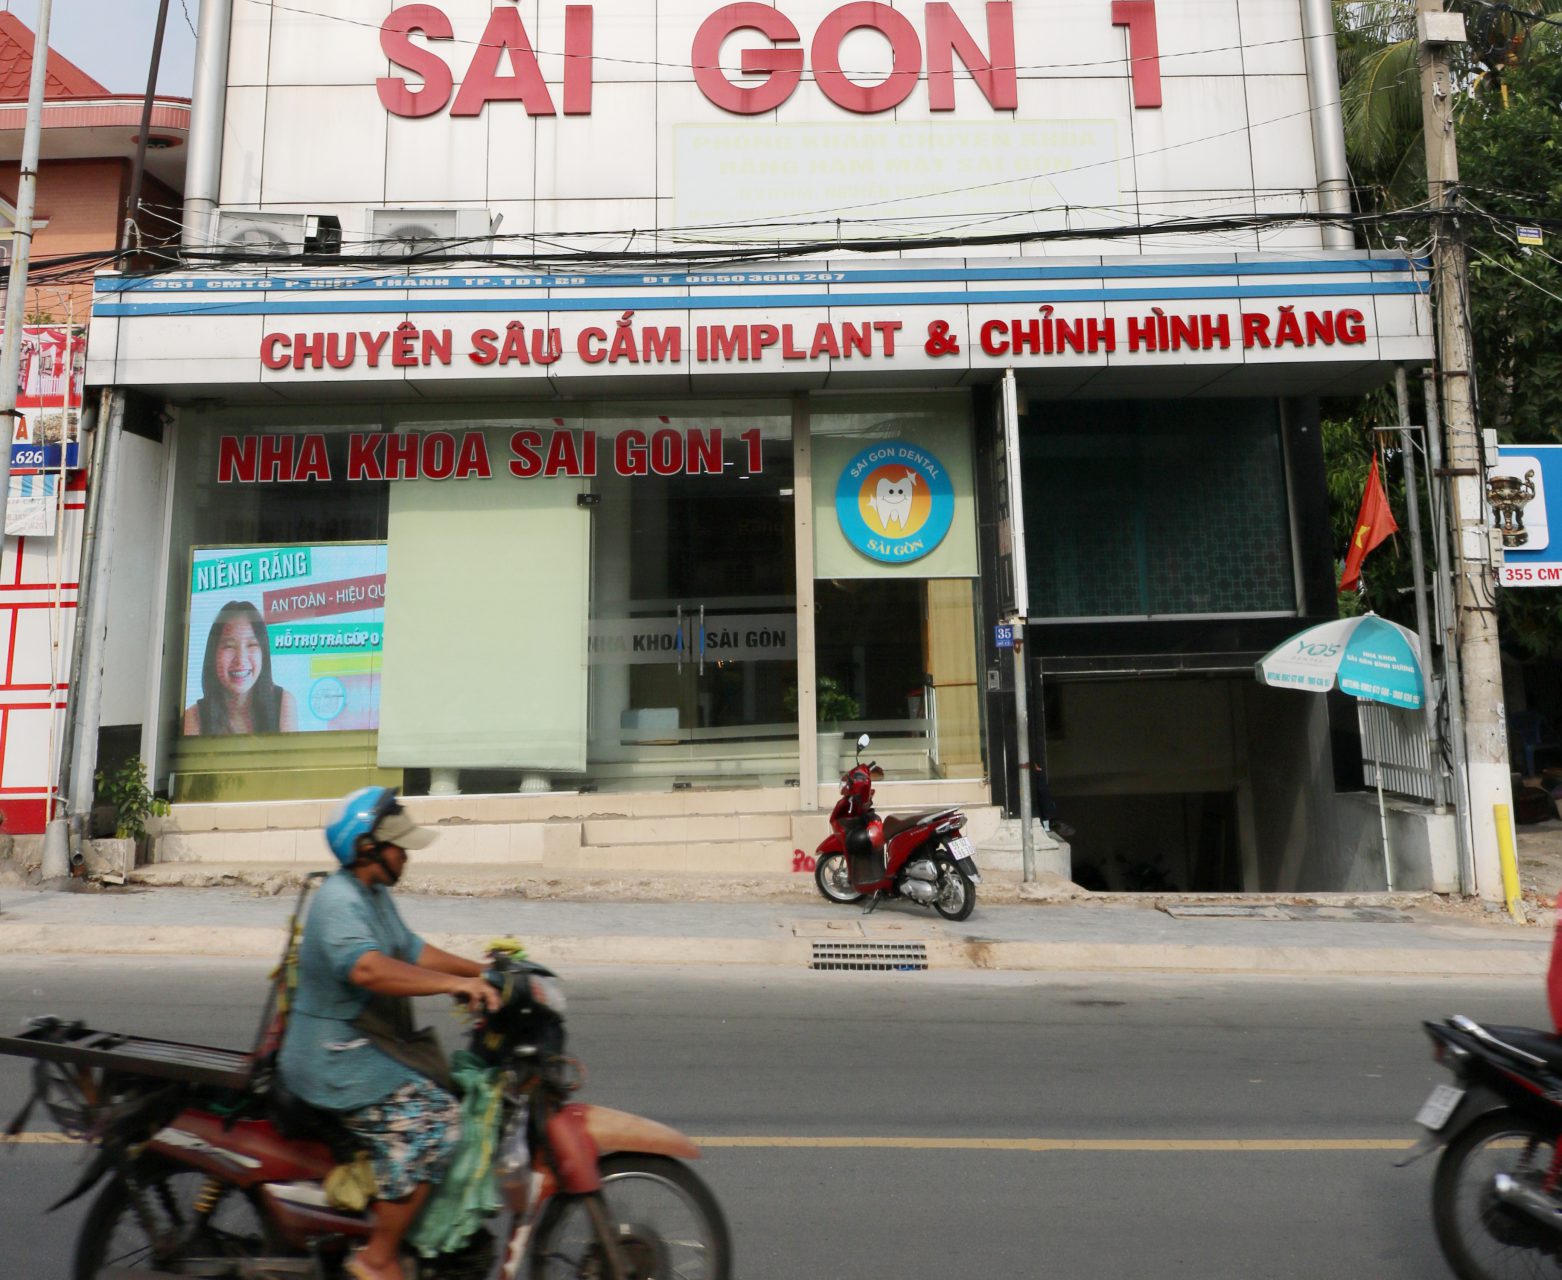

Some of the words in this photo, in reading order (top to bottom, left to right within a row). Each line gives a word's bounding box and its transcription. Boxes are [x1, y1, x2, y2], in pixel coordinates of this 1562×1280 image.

[260, 321, 452, 370] CHUYÊN
[468, 320, 562, 366] SÂU
[576, 310, 681, 364] CẮM
[697, 320, 902, 363] IMPLANT
[924, 319, 960, 358] &
[980, 304, 1116, 356] CHỈNH
[1127, 306, 1231, 353] HÌNH
[1241, 305, 1368, 349] RĂNG
[217, 433, 333, 484] NHA
[347, 430, 493, 481] KHOA
[508, 417, 598, 479] SÀI
[613, 415, 724, 477] GÒN
[739, 427, 764, 474] 1
[850, 459, 869, 478] SAI
[868, 447, 896, 463] GON
[898, 447, 940, 480] DENTAL
[867, 539, 890, 556] SÀI
[893, 539, 924, 556] GÒN
[197, 558, 253, 591] NIỀNG
[258, 551, 308, 583] RĂNG
[1505, 568, 1533, 581] 355
[271, 597, 290, 613] AN
[291, 591, 326, 610] TOÀN
[336, 585, 365, 605] HIỆU
[706, 627, 739, 649] SÀI
[744, 627, 787, 649] GÒN
[997, 628, 1012, 639] 35
